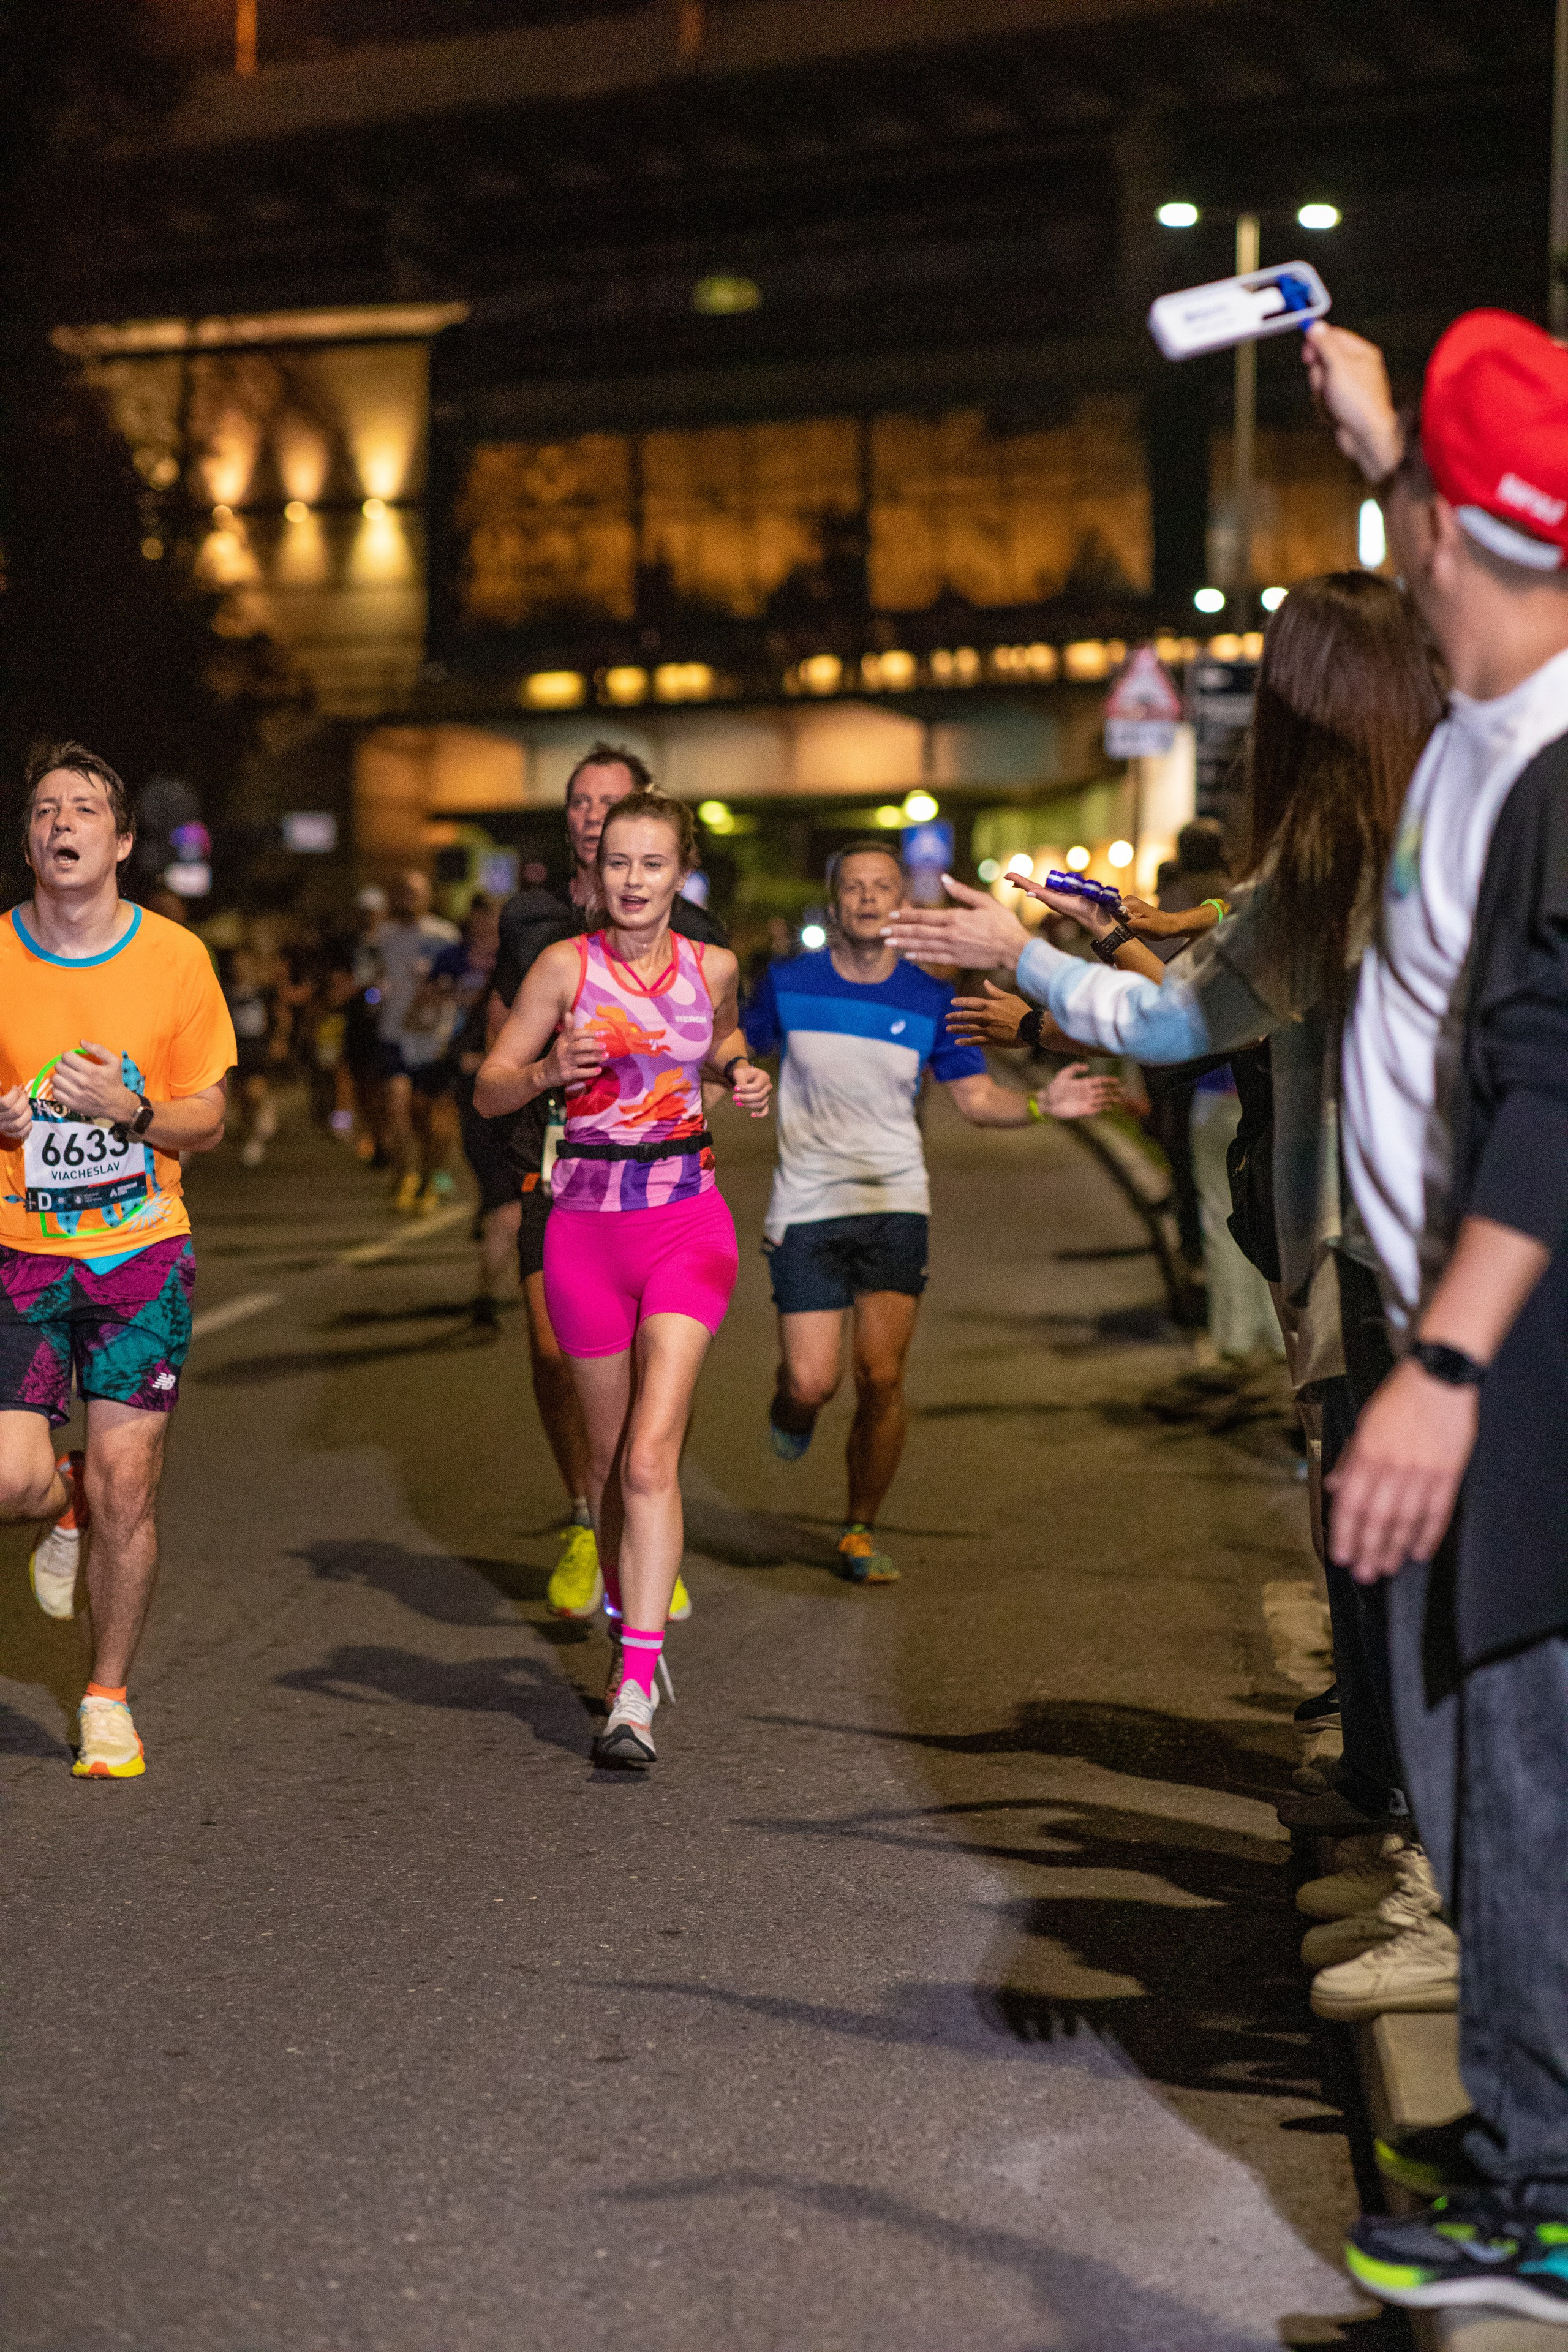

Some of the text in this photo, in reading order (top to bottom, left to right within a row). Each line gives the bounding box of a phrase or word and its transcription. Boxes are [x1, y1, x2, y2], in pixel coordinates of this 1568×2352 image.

[42, 1129, 129, 1166] 6633
[51, 1161, 119, 1181] VIACHESLAV
[37, 1192, 52, 1210] D
